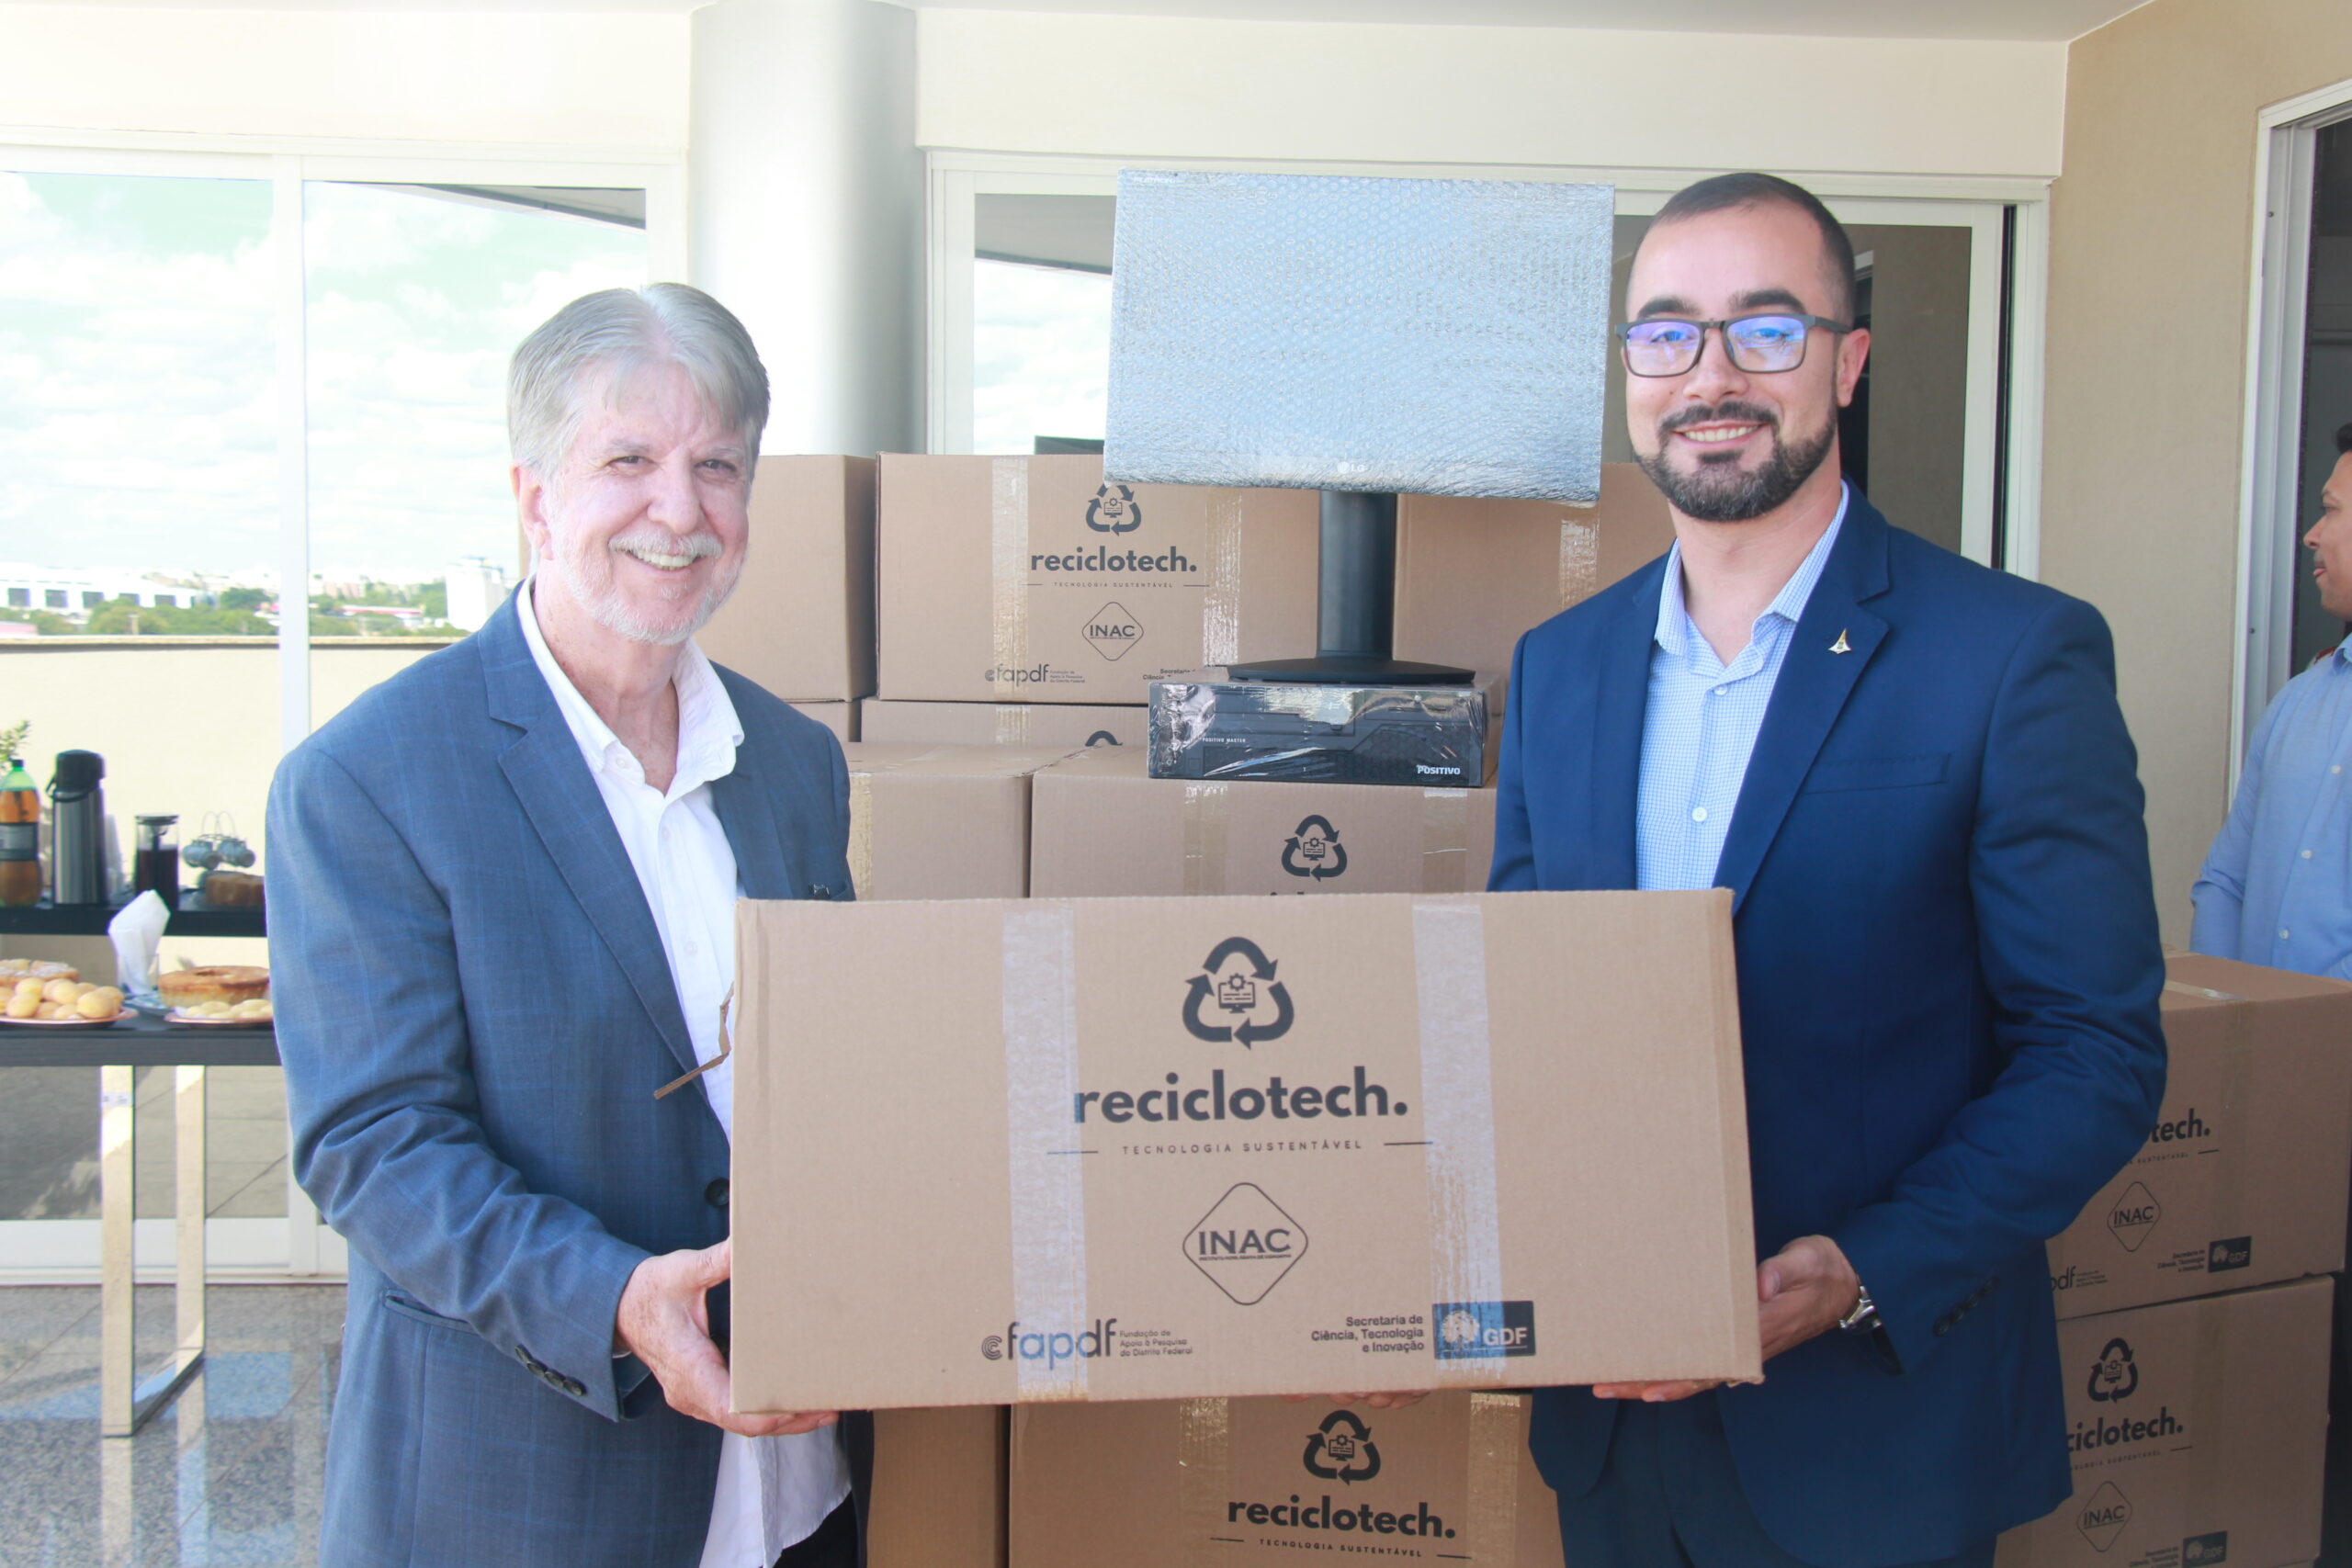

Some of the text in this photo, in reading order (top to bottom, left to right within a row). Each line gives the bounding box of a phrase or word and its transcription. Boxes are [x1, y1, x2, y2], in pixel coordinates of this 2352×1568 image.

[1031, 546, 1197, 572] reciclotech.
[1090, 625, 1136, 637] INAC
[1416, 764, 1461, 775] POSITIVO
[1074, 1066, 1408, 1123] reciclotech.
[1123, 1139, 1363, 1156] TECNOLOGIA SUSTENTÁVEL
[2114, 1206, 2154, 1225] INAC
[1198, 1228, 1292, 1255] INAC
[1346, 1314, 1423, 1327] Secretaria de
[1311, 1327, 1423, 1342] Ciência, Tecnologia
[1483, 1326, 1527, 1347] GDF
[1362, 1340, 1424, 1354] e Inovação
[1227, 1494, 1456, 1539] reciclotech.
[2084, 1505, 2125, 1526] INAC
[1260, 1538, 1422, 1558] TECNOLOGIA SUSTENTÁVEL
